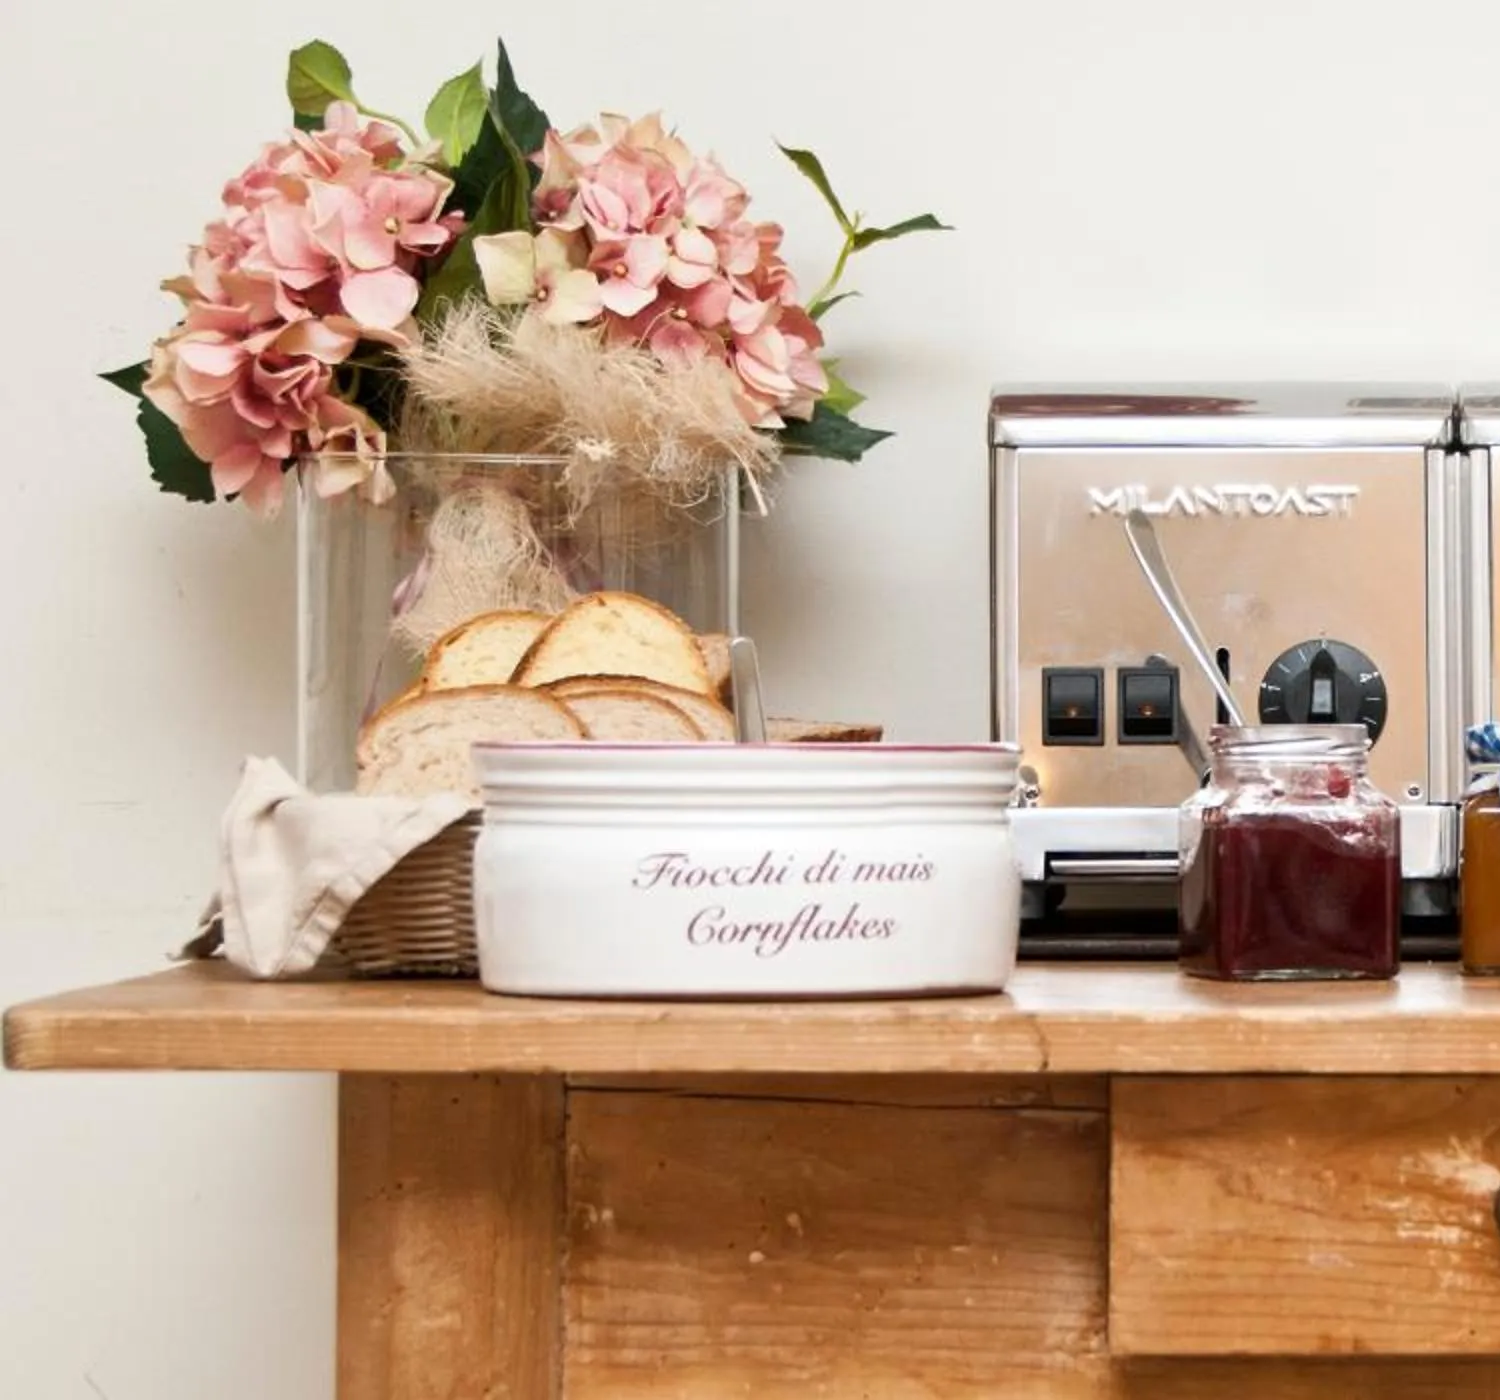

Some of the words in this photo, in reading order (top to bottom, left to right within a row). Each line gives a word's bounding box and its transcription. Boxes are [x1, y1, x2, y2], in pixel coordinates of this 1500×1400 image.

[1087, 484, 1361, 518] MILANTOAST
[632, 850, 794, 889] Fiocchi
[803, 848, 847, 884] di
[851, 853, 934, 882] mais
[686, 902, 896, 958] Cornflakes
